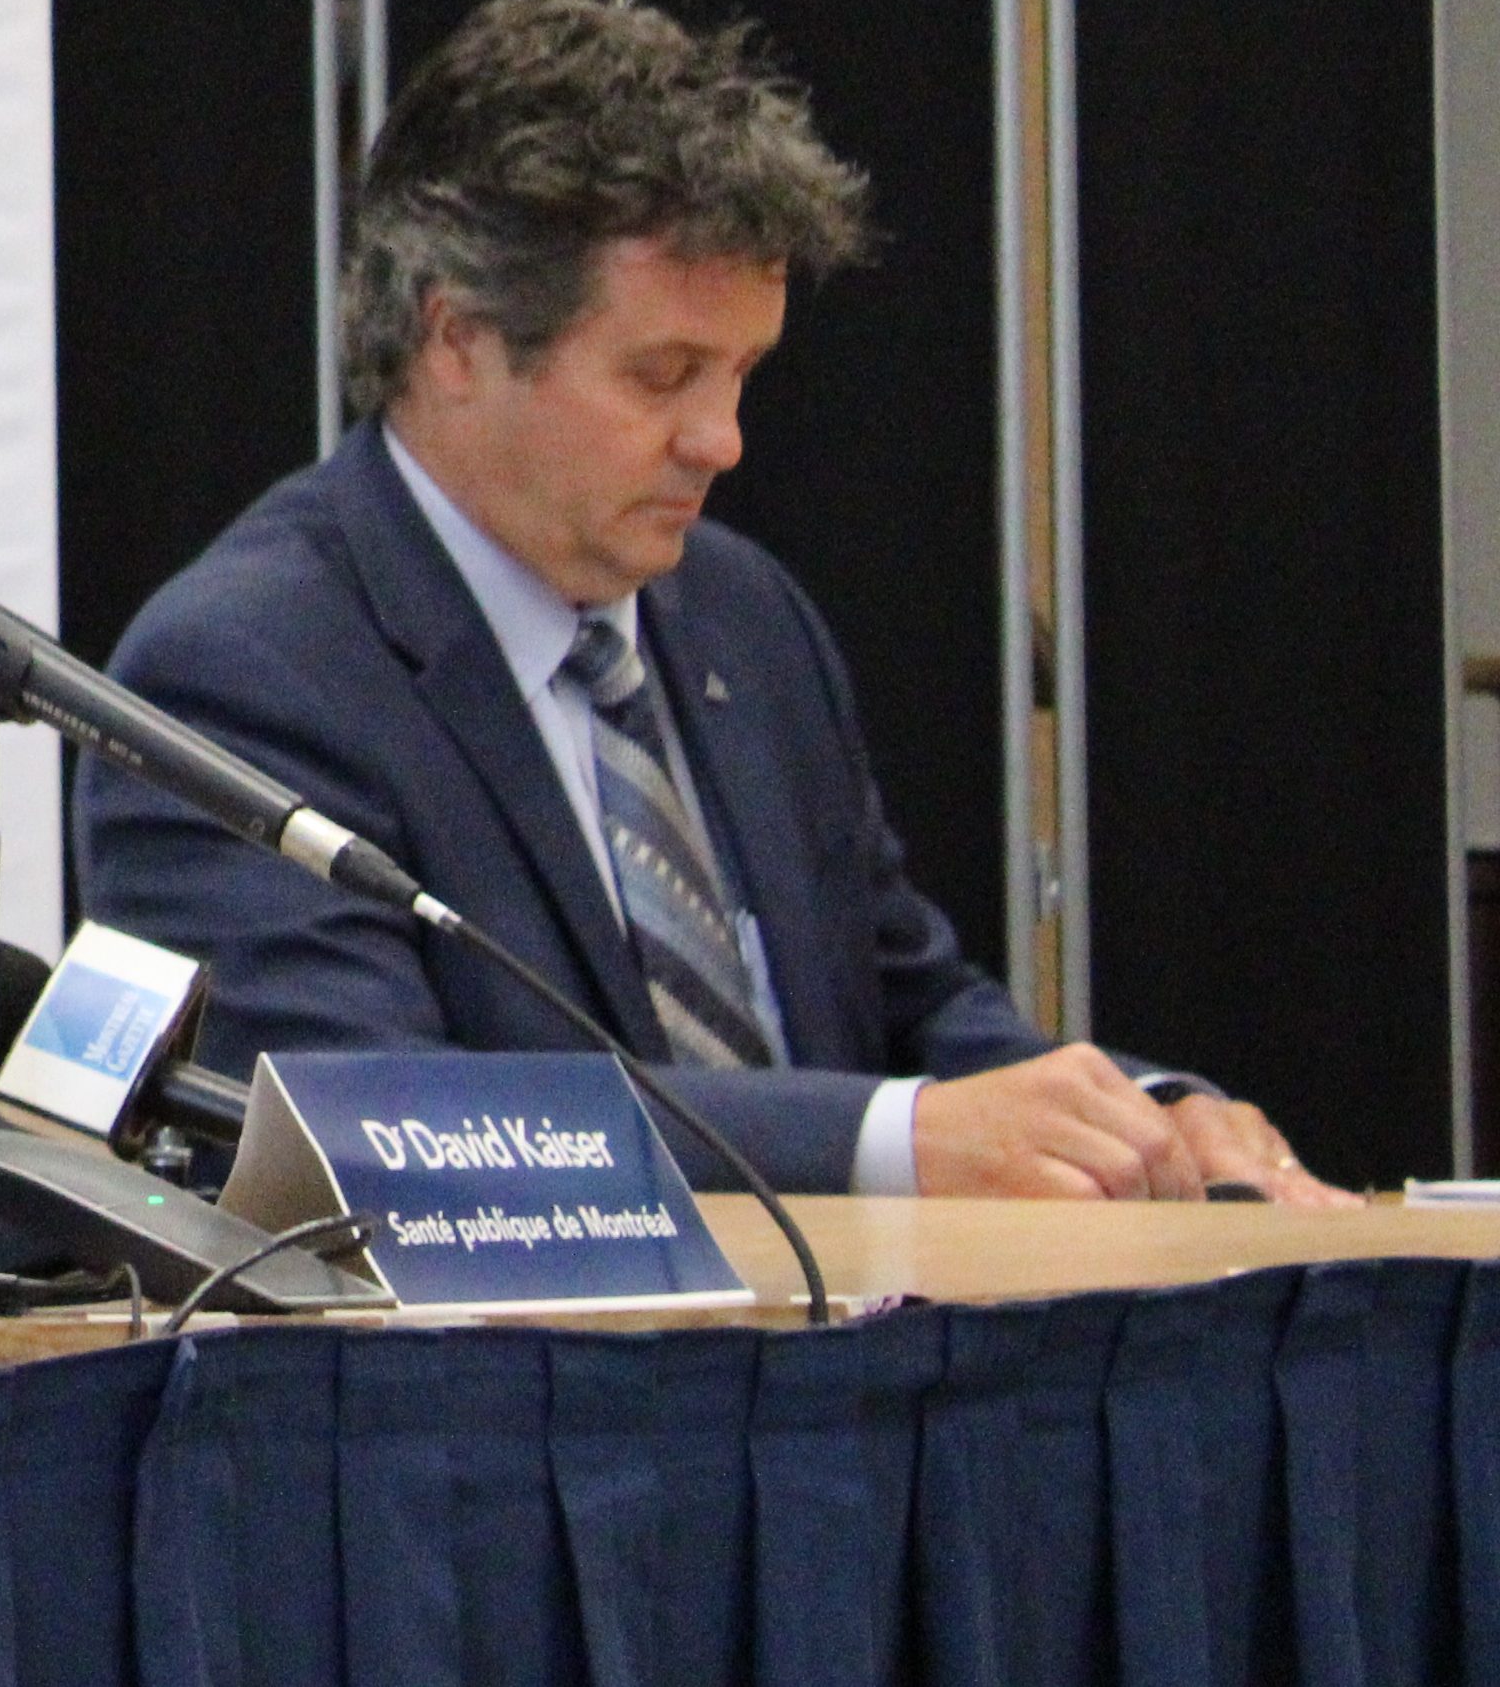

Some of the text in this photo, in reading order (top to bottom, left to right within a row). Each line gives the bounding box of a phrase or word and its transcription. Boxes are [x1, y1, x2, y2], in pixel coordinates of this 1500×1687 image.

[401, 1114, 517, 1170] David
[502, 1116, 615, 1169] Kaiser
[387, 1202, 678, 1253] Santé publique de Montréal
